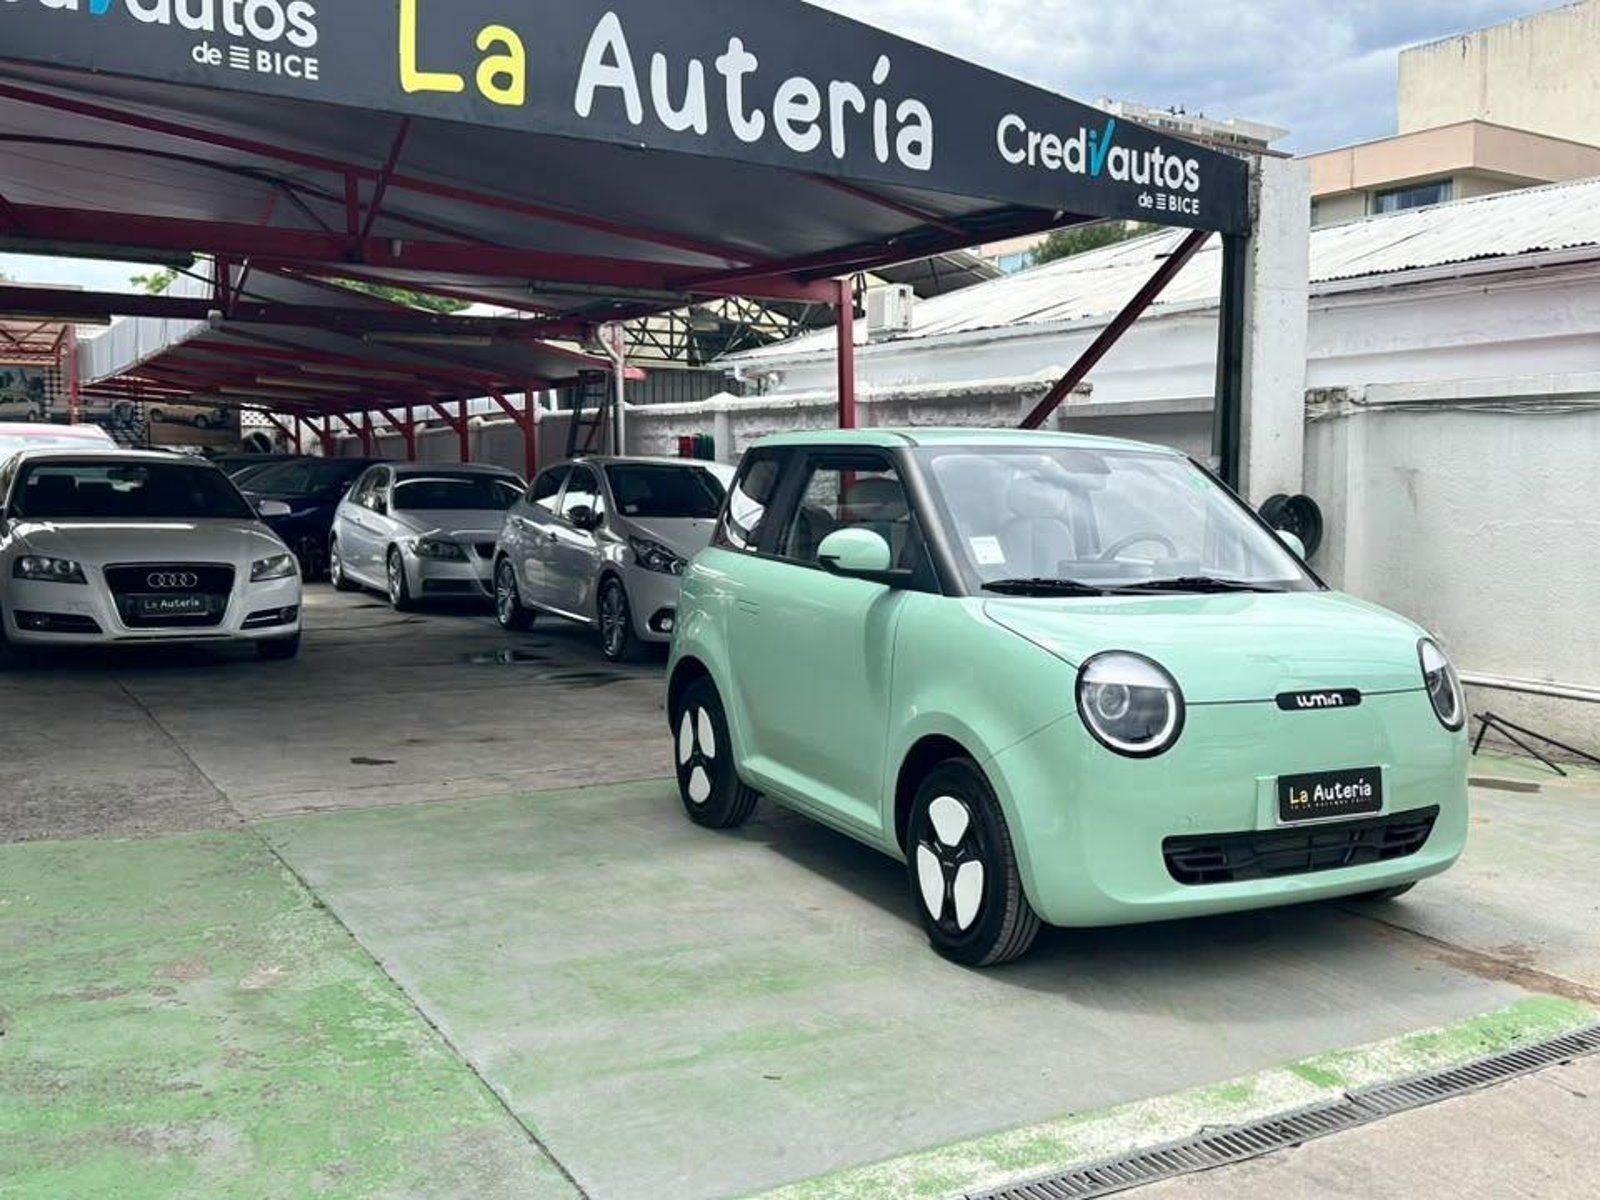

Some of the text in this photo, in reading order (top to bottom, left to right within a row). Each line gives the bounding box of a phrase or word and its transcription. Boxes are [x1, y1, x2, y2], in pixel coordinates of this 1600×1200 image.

[192, 41, 319, 81] de BICE
[399, 0, 934, 171] La Autería
[1137, 191, 1200, 215] de BICE
[1289, 786, 1309, 805] La
[1313, 778, 1373, 802] Autería
